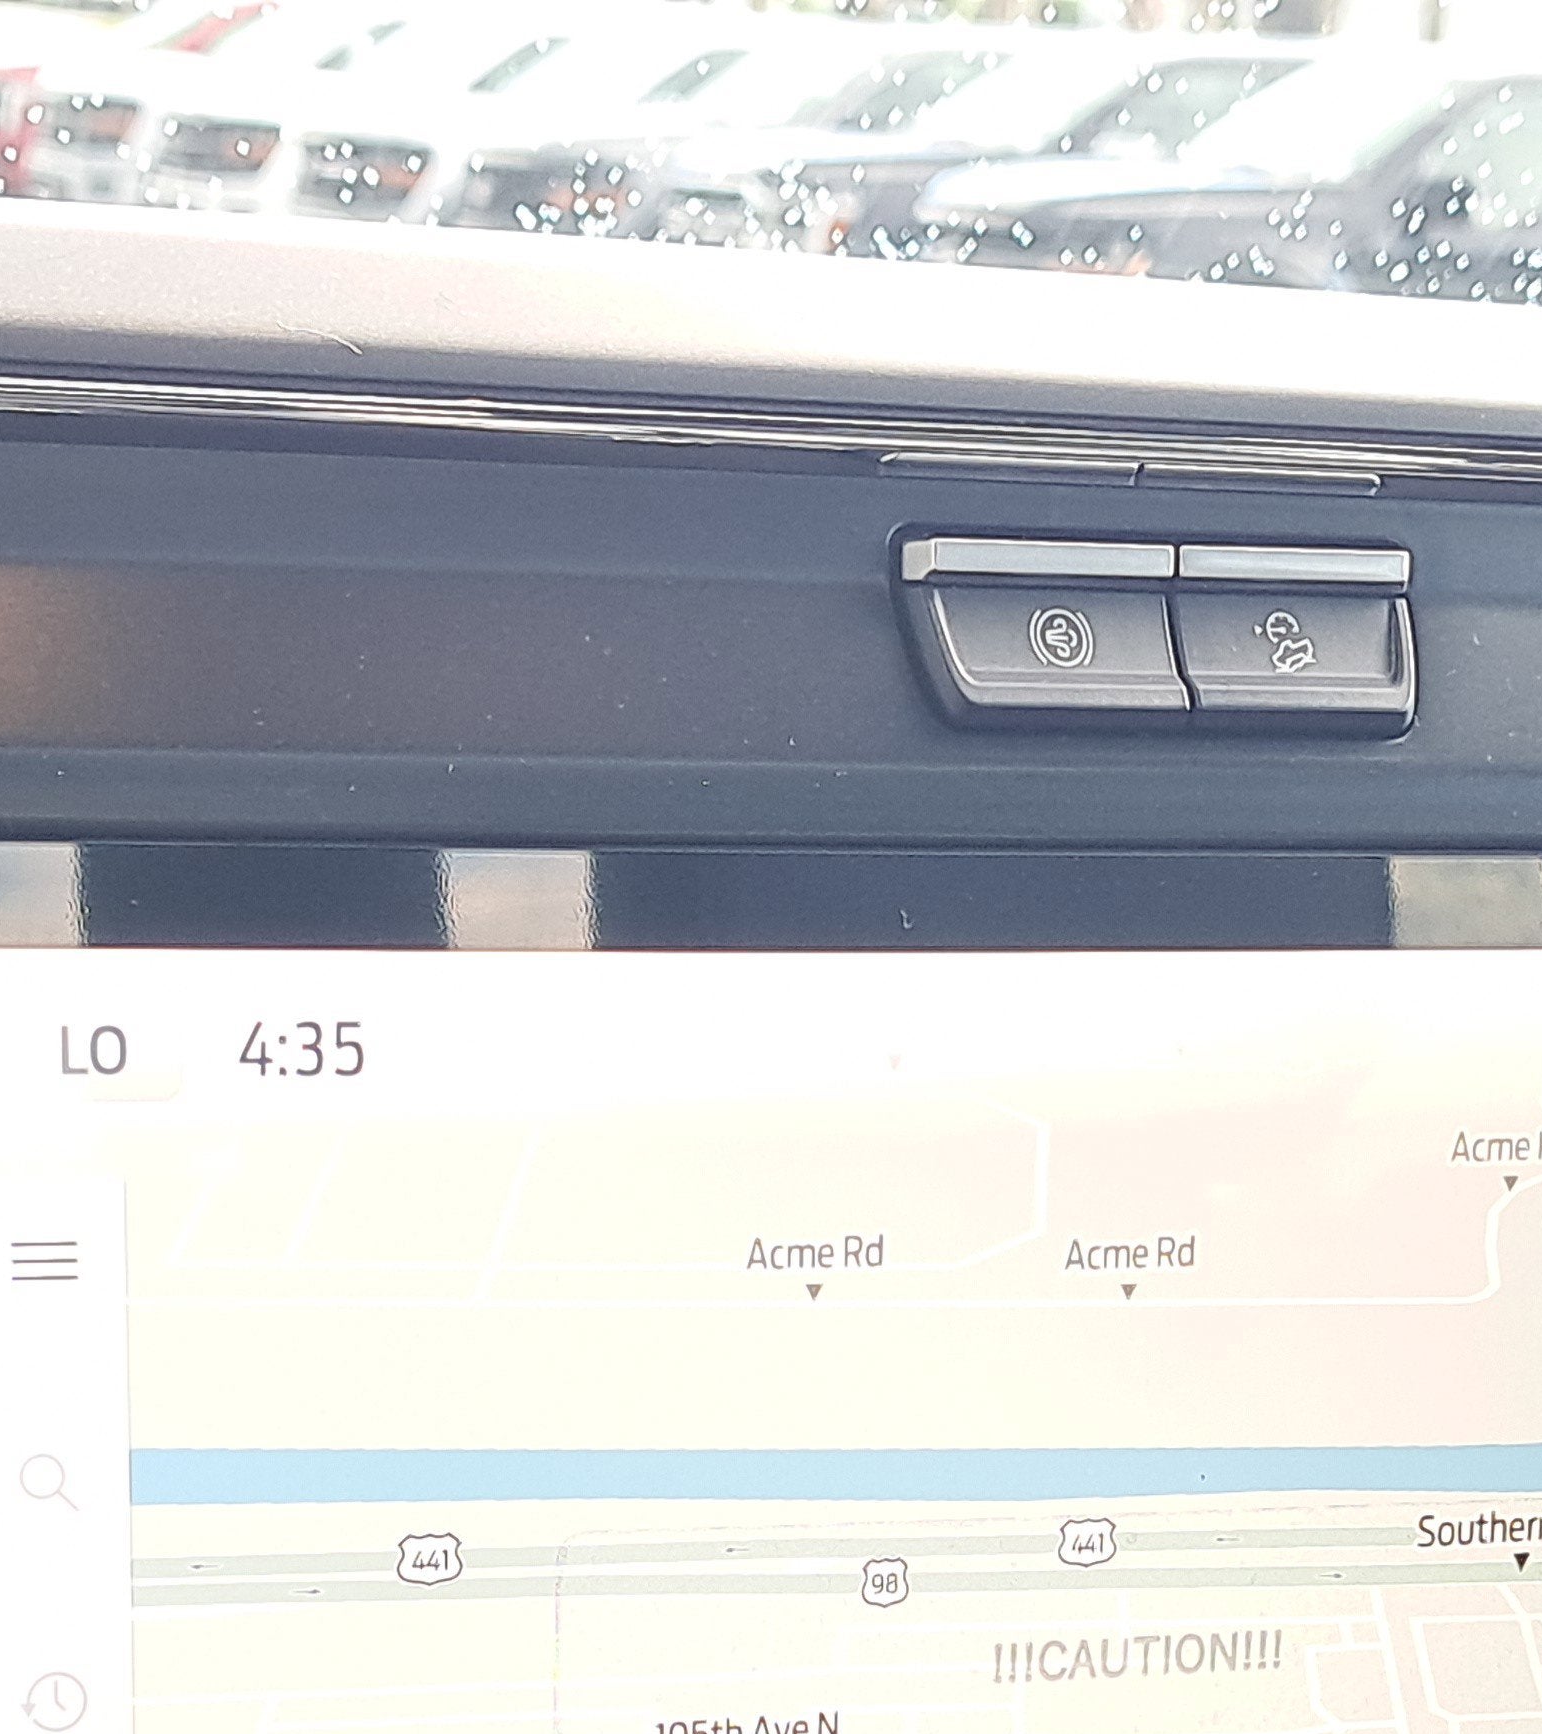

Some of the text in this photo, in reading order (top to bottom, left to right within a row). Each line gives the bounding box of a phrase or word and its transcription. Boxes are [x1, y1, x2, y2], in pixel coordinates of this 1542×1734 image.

[61, 1025, 127, 1075] LO
[239, 1021, 365, 1077] 4:35
[1452, 1133, 1531, 1164] Acme
[748, 1235, 884, 1270] Acme Rd
[1065, 1237, 1195, 1271] Acme Rd
[1072, 1533, 1105, 1554] 441
[411, 1550, 450, 1573] 441
[873, 1573, 898, 1596] 98
[994, 1631, 1282, 1683] !!!CAUTION!!!
